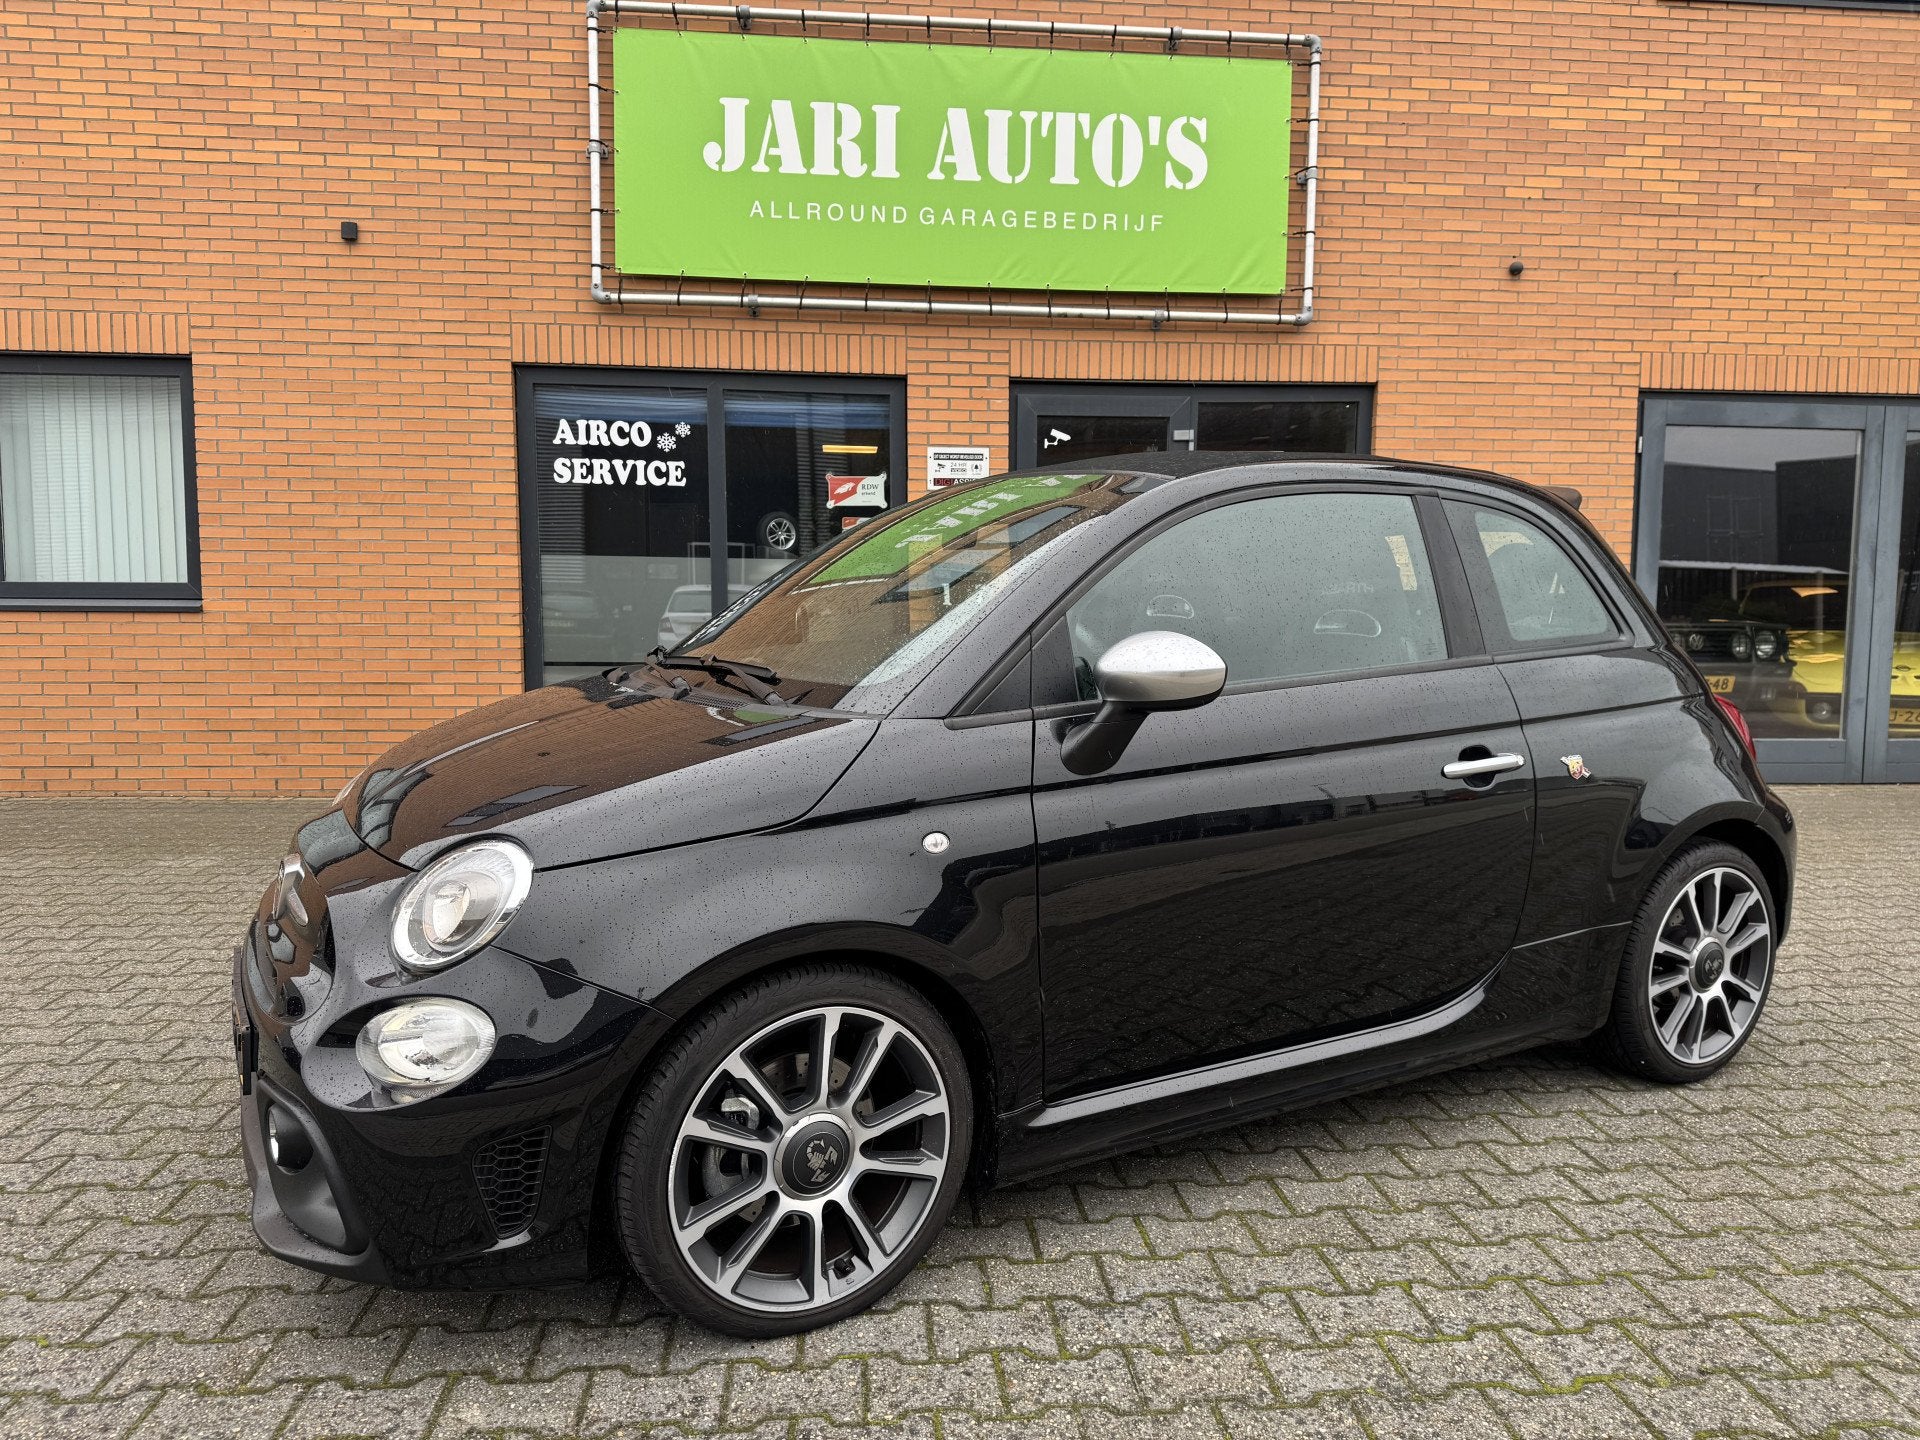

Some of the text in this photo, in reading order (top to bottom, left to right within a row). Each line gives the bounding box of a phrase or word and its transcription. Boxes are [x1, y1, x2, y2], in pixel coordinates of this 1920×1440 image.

[703, 97, 1208, 190] JARI AUTO'S
[750, 200, 1163, 232] ALLROUND GARAGEBEDRIJF
[552, 418, 652, 447] AIRCO
[553, 457, 687, 487] SERVICE
